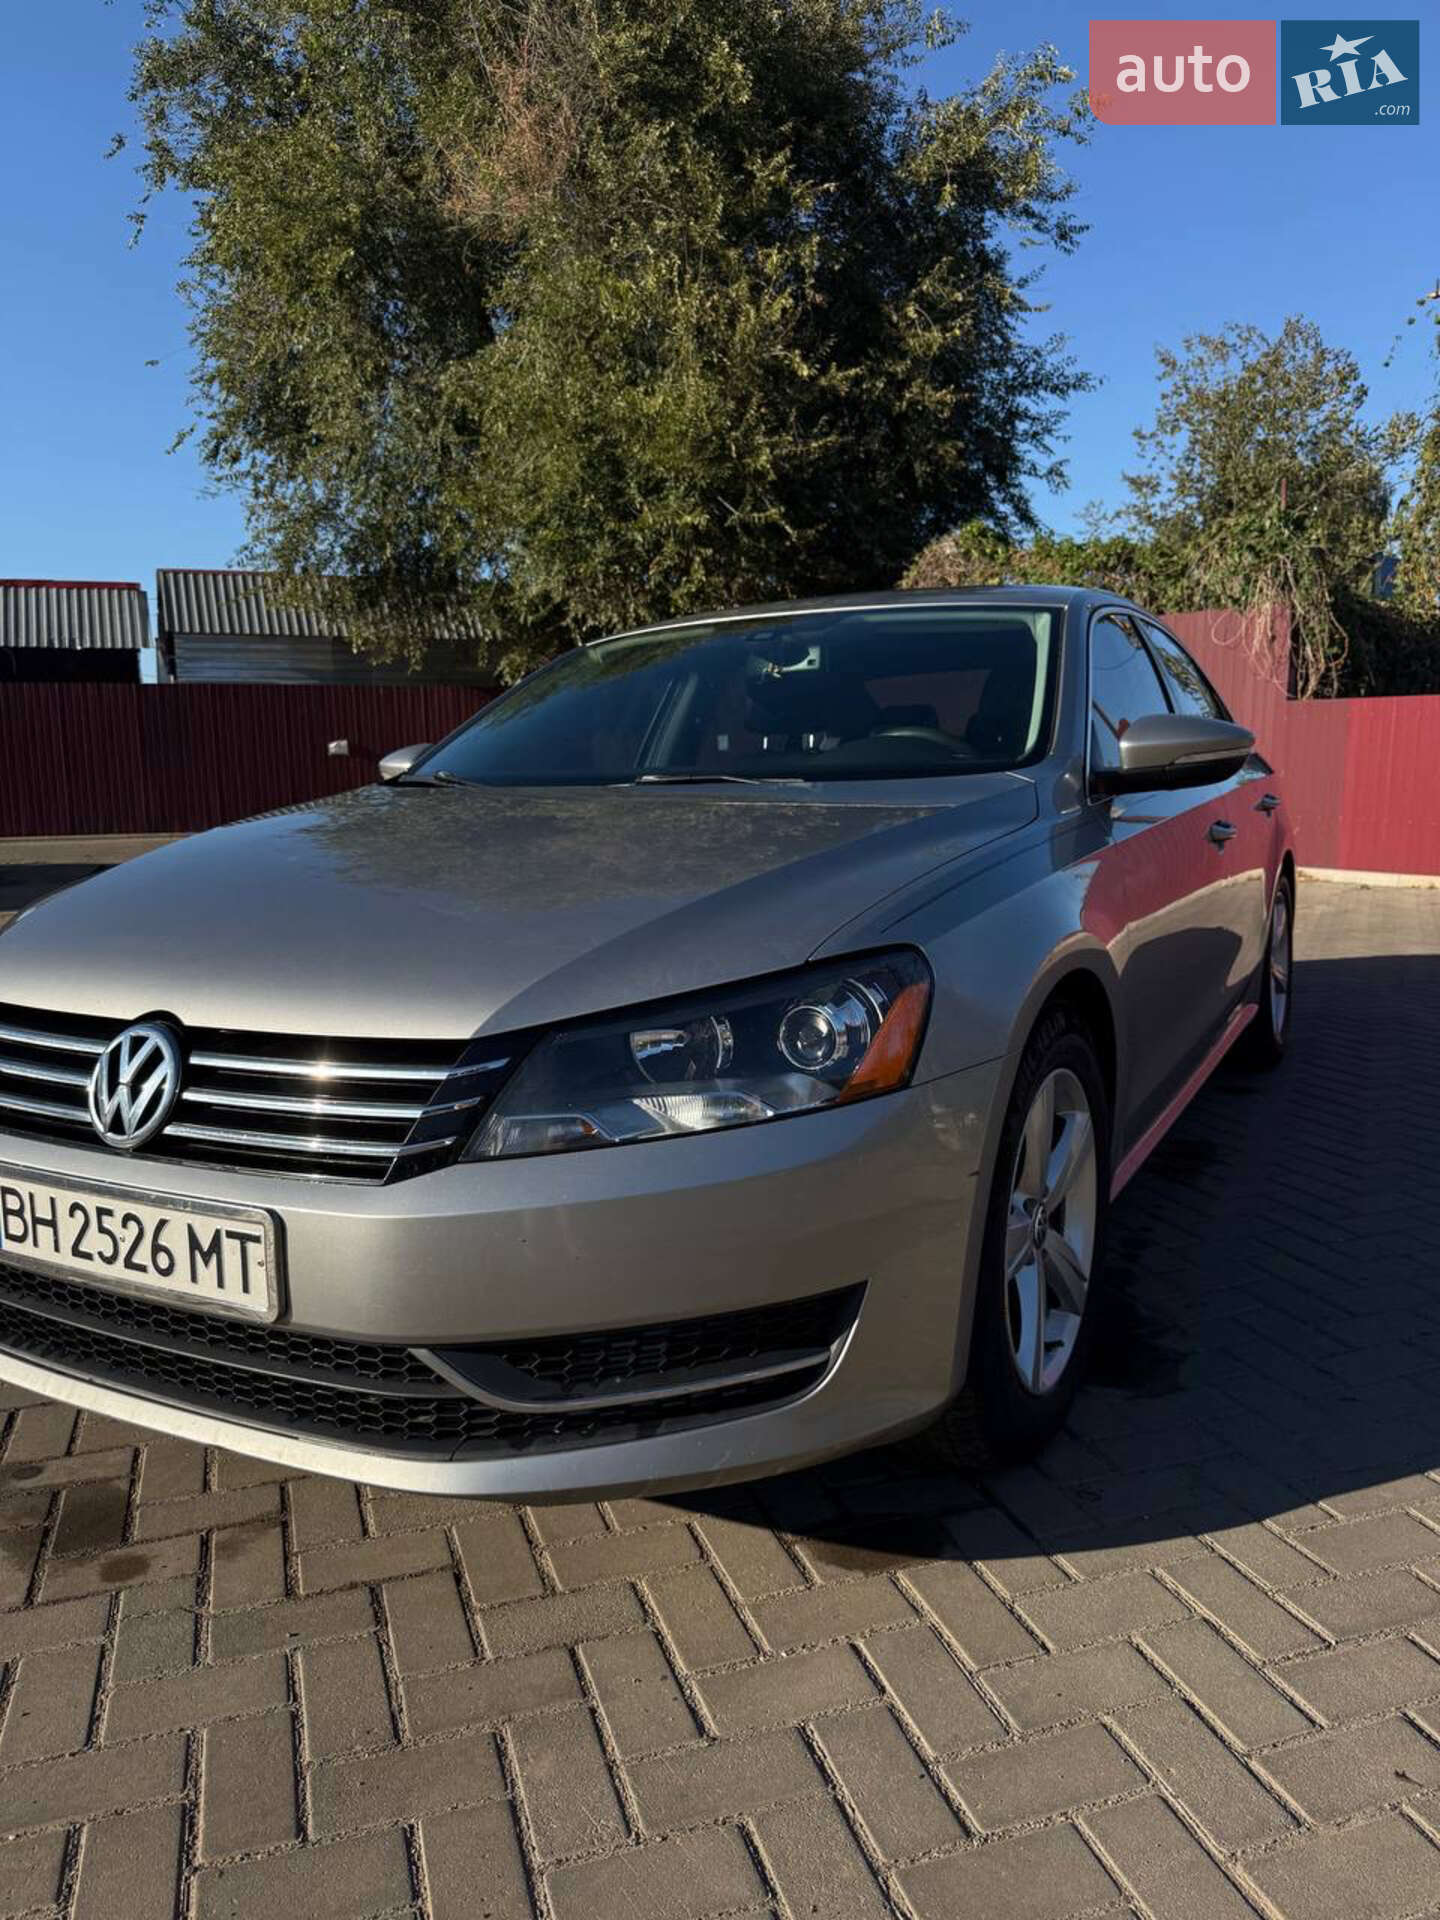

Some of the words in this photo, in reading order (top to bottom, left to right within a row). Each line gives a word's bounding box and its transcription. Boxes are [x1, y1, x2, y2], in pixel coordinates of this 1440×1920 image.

[1, 1186, 60, 1253] BH
[68, 1201, 175, 1278] 2526
[187, 1223, 261, 1295] MT
